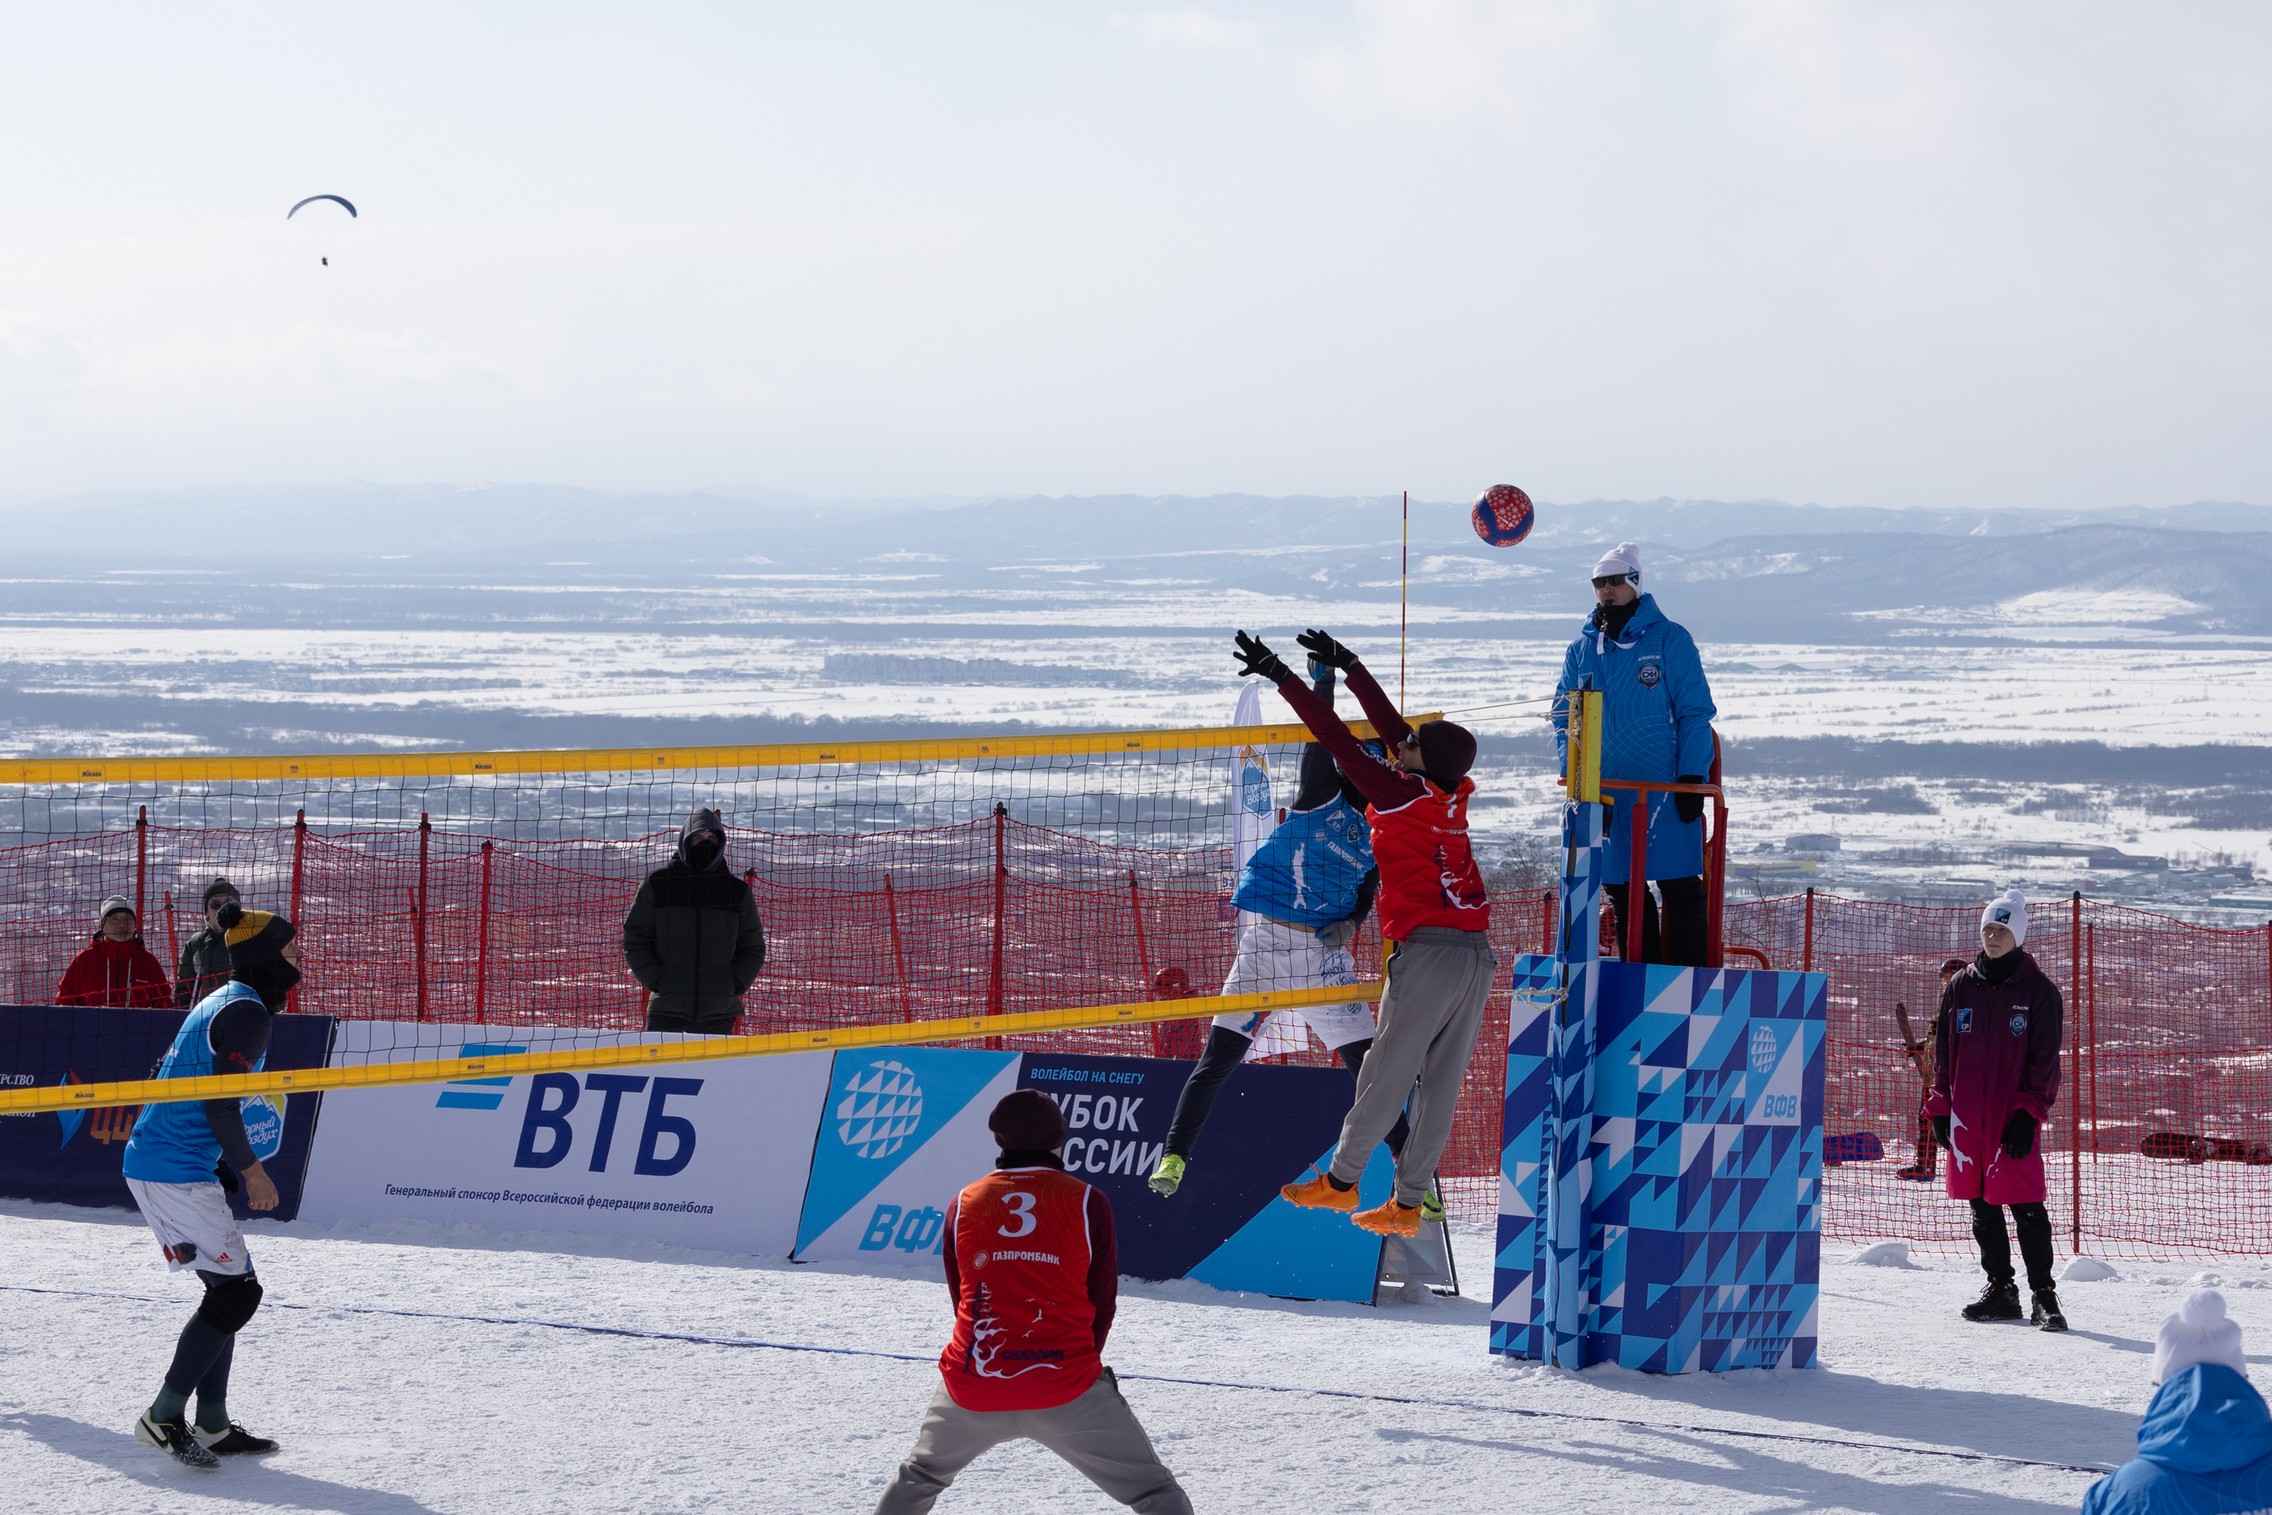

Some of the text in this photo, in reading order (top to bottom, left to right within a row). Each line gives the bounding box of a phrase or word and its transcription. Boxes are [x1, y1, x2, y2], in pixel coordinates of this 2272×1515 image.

[0, 1074, 34, 1086] РСТВО
[1031, 1067, 1145, 1085] ВОЛЕЙБОЛ НА СНЕГУ
[1044, 1092, 1144, 1132] УБОК
[1763, 1094, 1798, 1118] ВФВ
[247, 1129, 278, 1146] оздух
[513, 1072, 705, 1177] ВТБ
[1063, 1137, 1164, 1176] ССИИ
[385, 1184, 714, 1214] Генеральный спонсор Всероссийской федерации волейбола
[997, 1192, 1037, 1238] 3
[993, 1251, 1060, 1265] ГАЗПРОМБАНК
